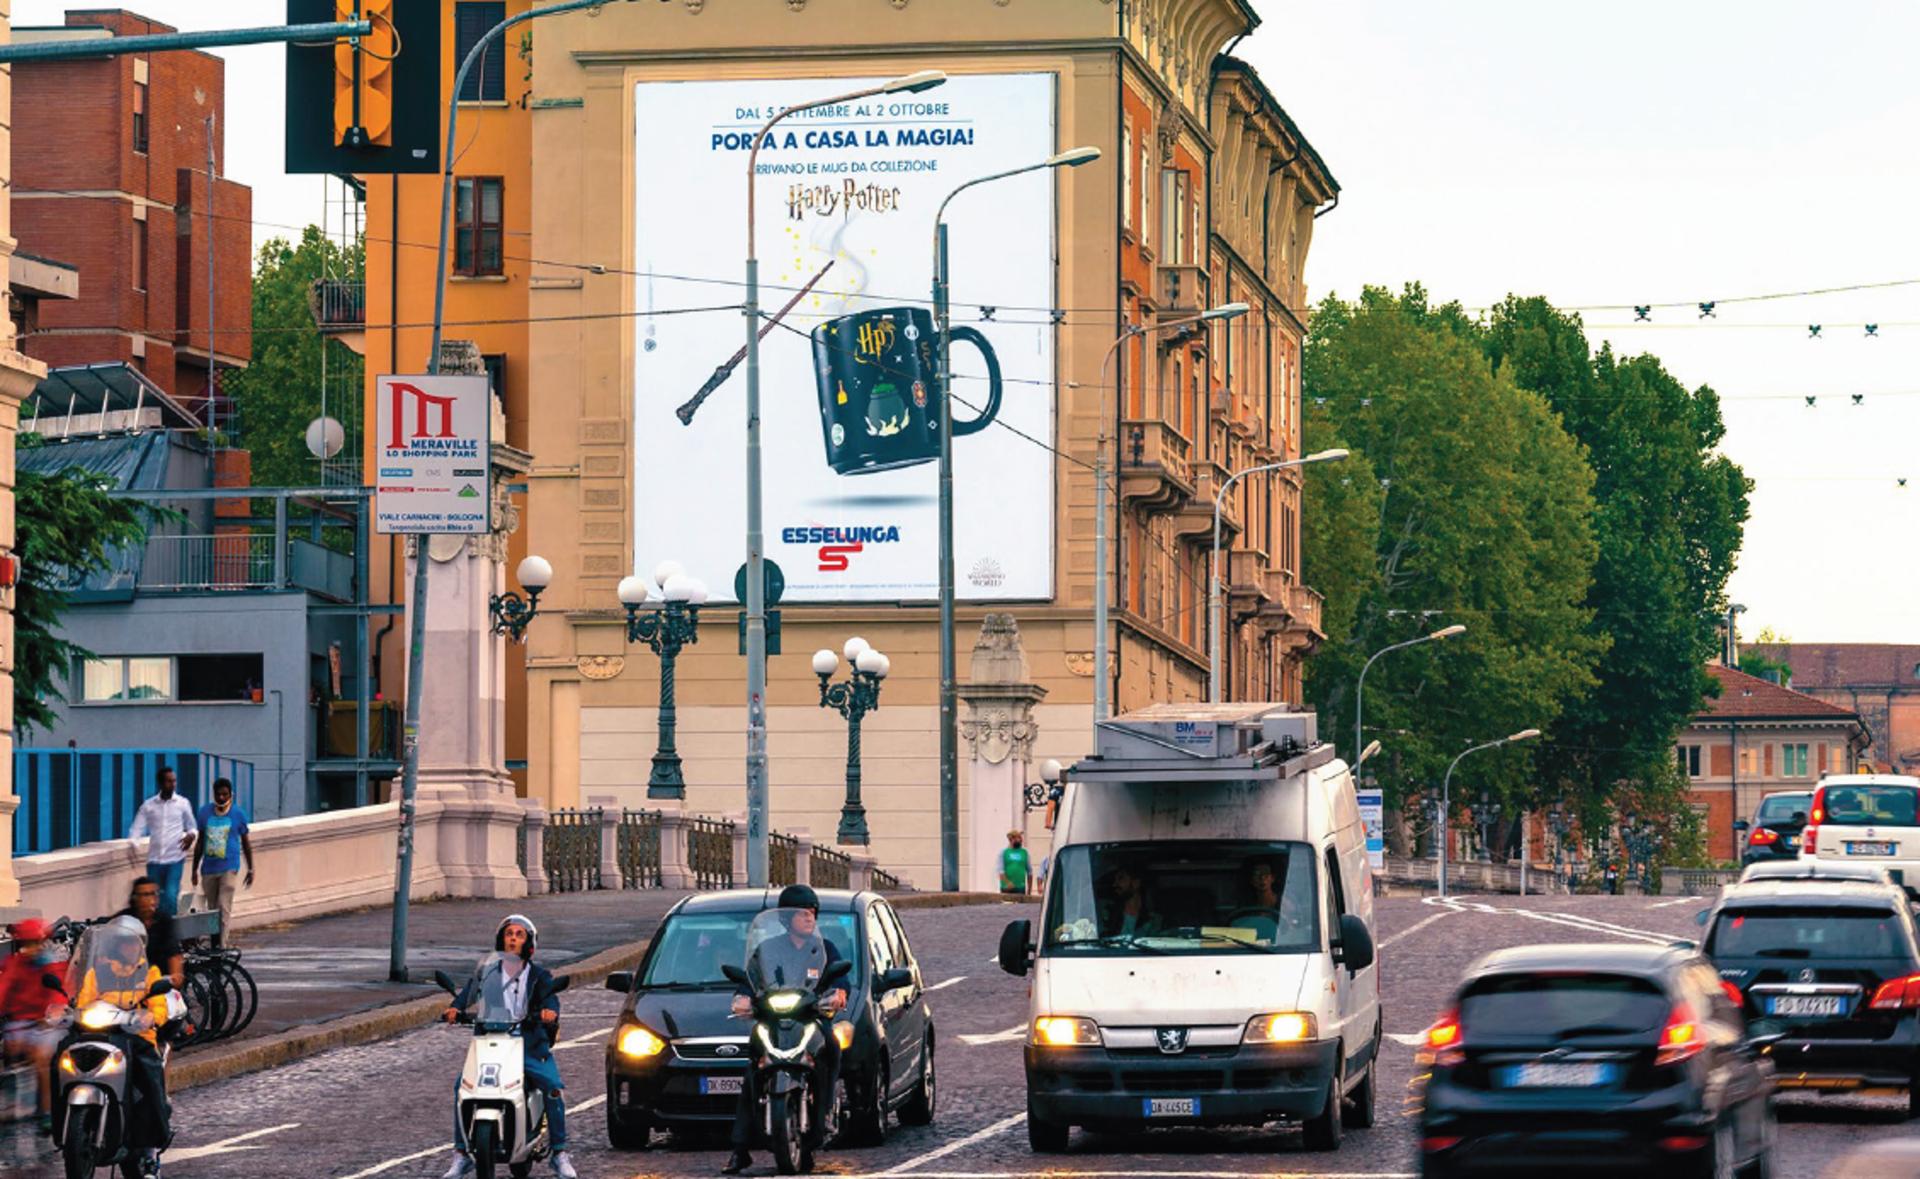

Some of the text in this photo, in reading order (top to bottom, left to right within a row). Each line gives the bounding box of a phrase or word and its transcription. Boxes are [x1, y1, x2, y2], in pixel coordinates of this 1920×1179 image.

[735, 107, 761, 120] DAL
[766, 107, 775, 118] 5
[855, 104, 872, 117] AL
[876, 104, 885, 117] 2
[889, 103, 950, 116] OTTOBRE
[783, 132, 799, 150] A
[805, 130, 860, 149] CASA
[865, 129, 890, 147] LA
[896, 127, 975, 147] MAGIA!
[748, 159, 938, 175] RRIVANO LE MUG DA COLLEZIONE
[784, 177, 901, 224] Harry Potter
[410, 439, 478, 450] MERAVILLE
[386, 449, 478, 459] LO SHOPPING PARK
[447, 513, 484, 521] BOLOGNA
[782, 526, 900, 544] ESSELUNGA
